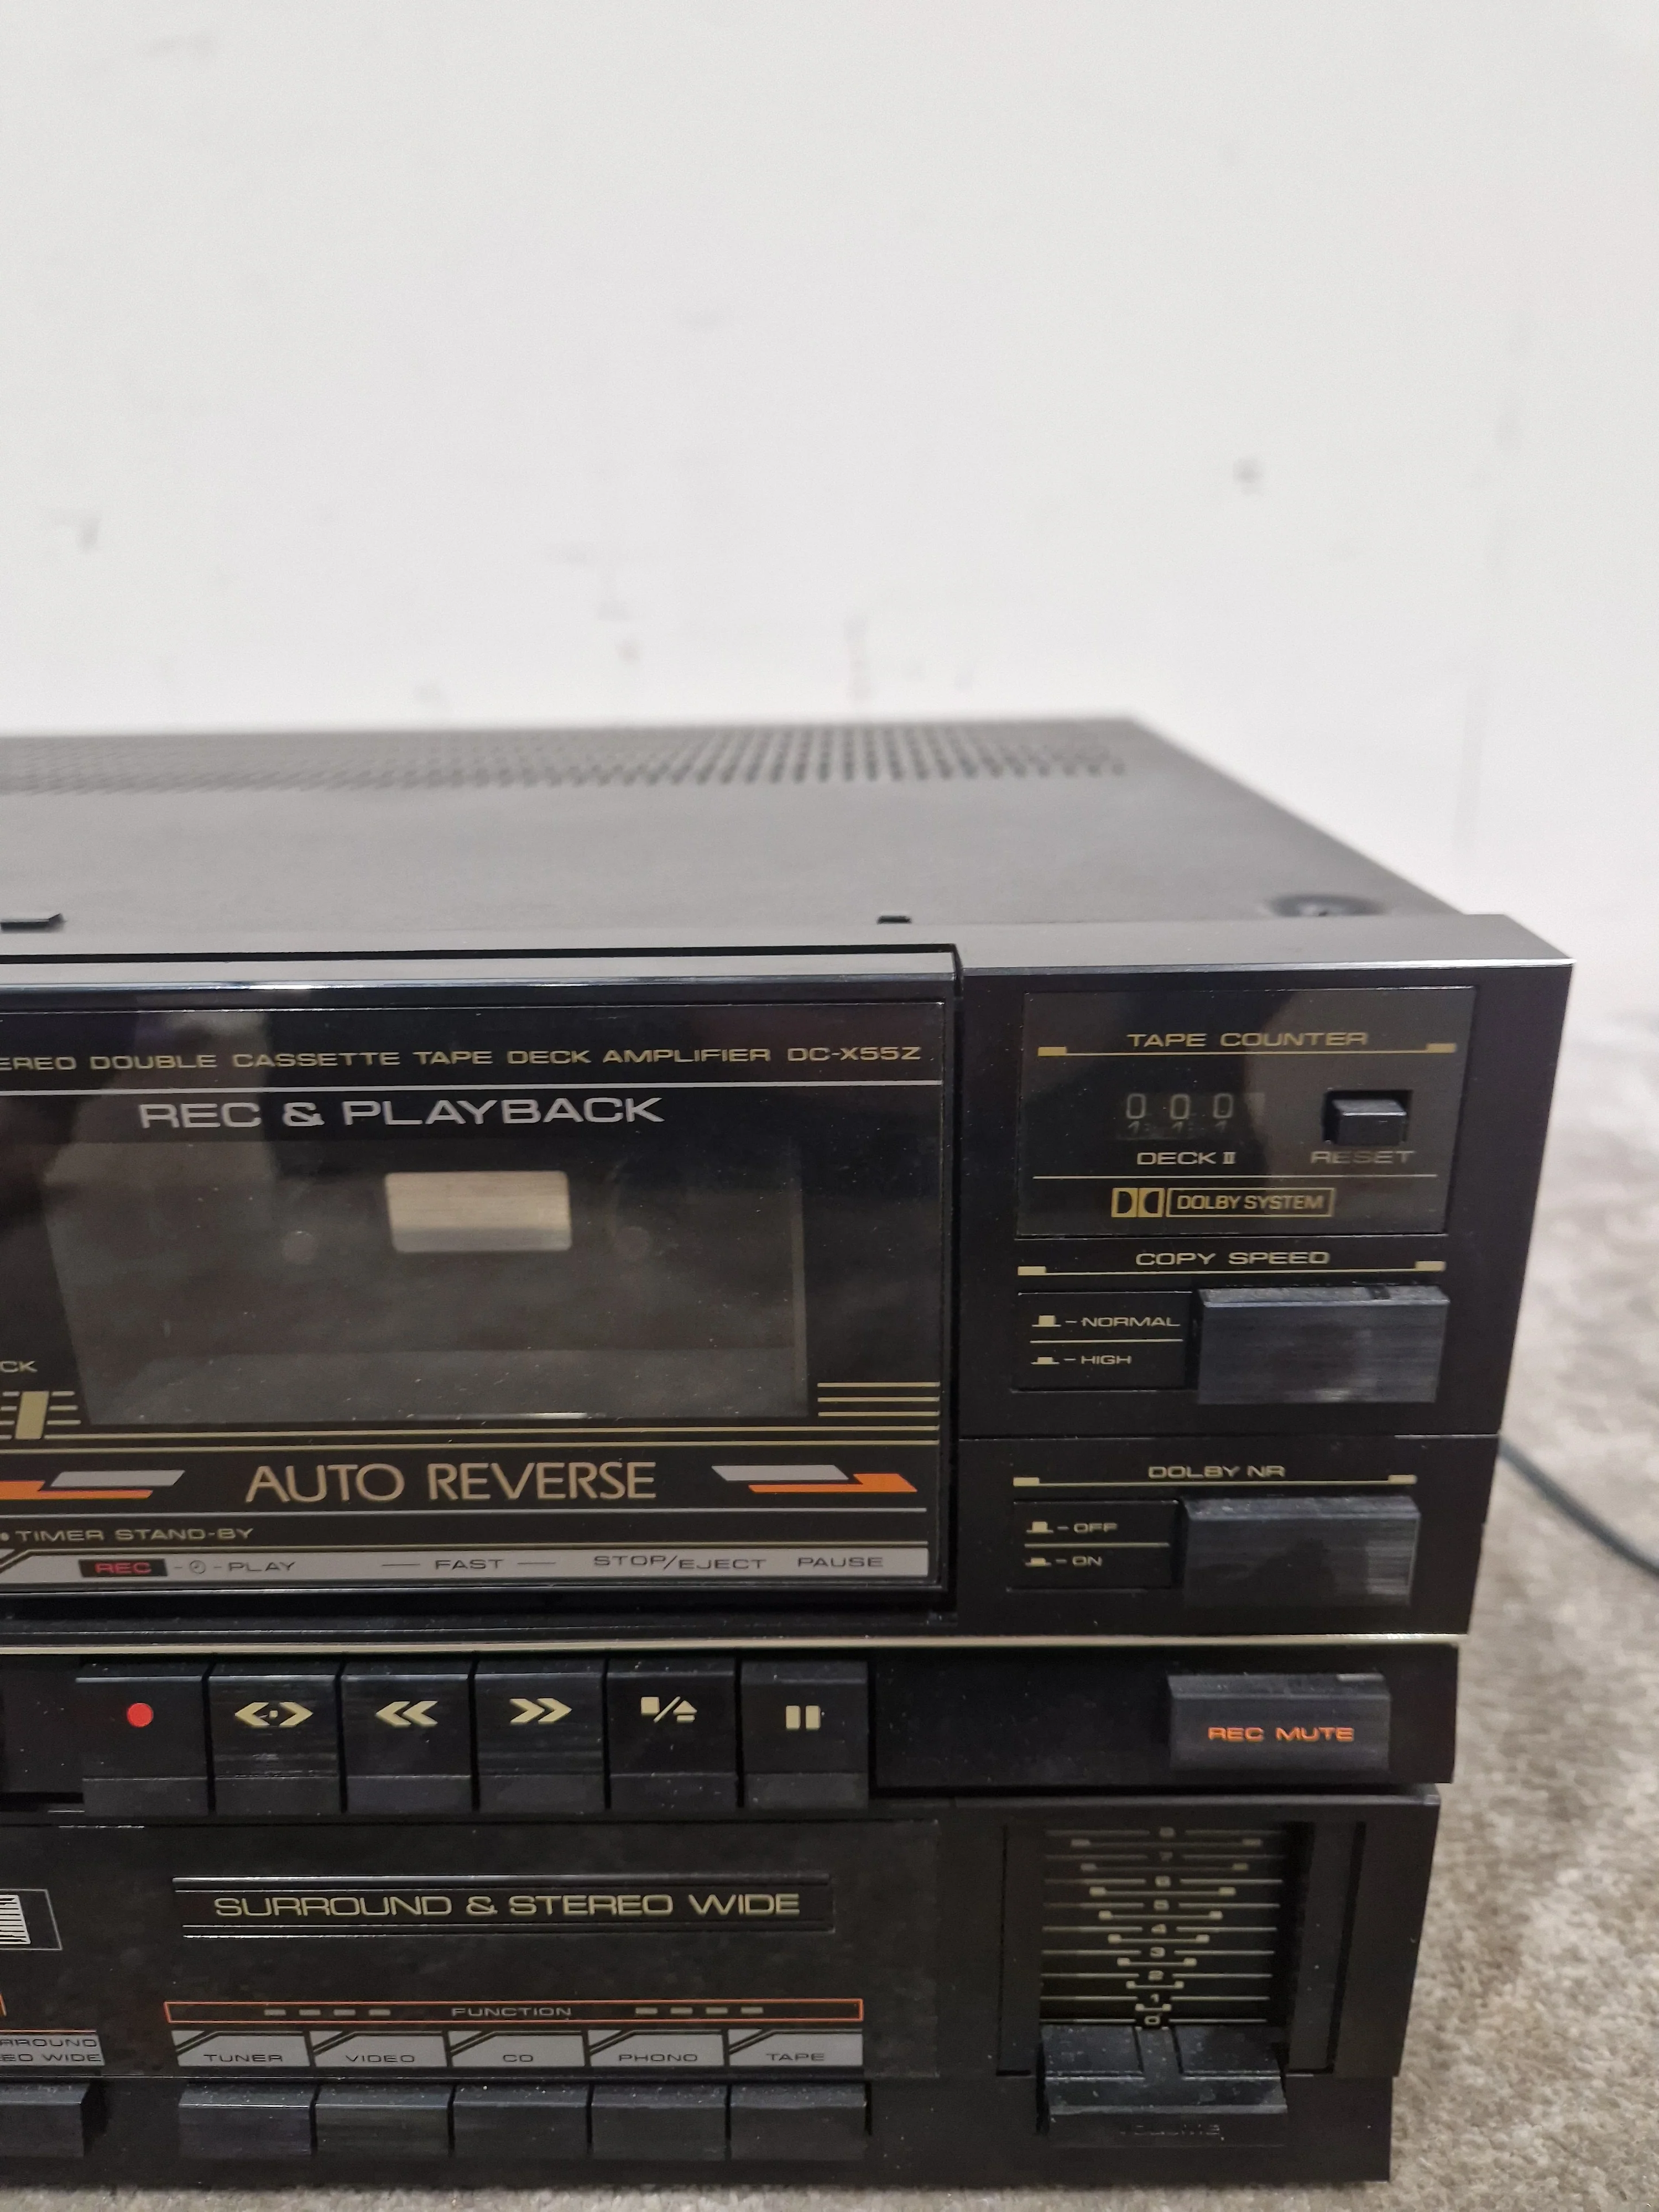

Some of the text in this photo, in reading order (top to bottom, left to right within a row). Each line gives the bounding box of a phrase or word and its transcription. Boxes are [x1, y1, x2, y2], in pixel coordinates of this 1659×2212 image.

[1127, 1032, 1369, 1047] TAPE COUNTER
[0, 1047, 921, 1071] EREO DOUBLE CASSETTE TAPE DECK AMPLIFIER DC-X55Z
[139, 1096, 665, 1128] REC & PLAYBACK
[1137, 1152, 1217, 1165] DECK
[1311, 1151, 1415, 1164] RESET
[1177, 1195, 1324, 1209] DOLBY SYSTEM
[1135, 1251, 1331, 1266] COPY SPEED
[1081, 1317, 1180, 1327] NORMAL
[1081, 1355, 1132, 1364] HIGH
[1149, 1465, 1285, 1479] DOLBY NR
[246, 1462, 656, 1503] AUTO REVERSE
[15, 1528, 254, 1541] TIMER STAND-BY
[1073, 1523, 1117, 1533] OFF
[95, 1562, 152, 1574] REC
[229, 1562, 295, 1572] PLAY
[435, 1559, 504, 1569] FAST
[593, 1555, 767, 1570] STOP/EJECT
[797, 1557, 883, 1568] PAUSE
[1072, 1556, 1103, 1567] ON
[1208, 1727, 1354, 1741] REC MUTE
[215, 1894, 801, 1917] SURROUND & STEREO WIDE
[452, 2007, 572, 2017] FUNCTION
